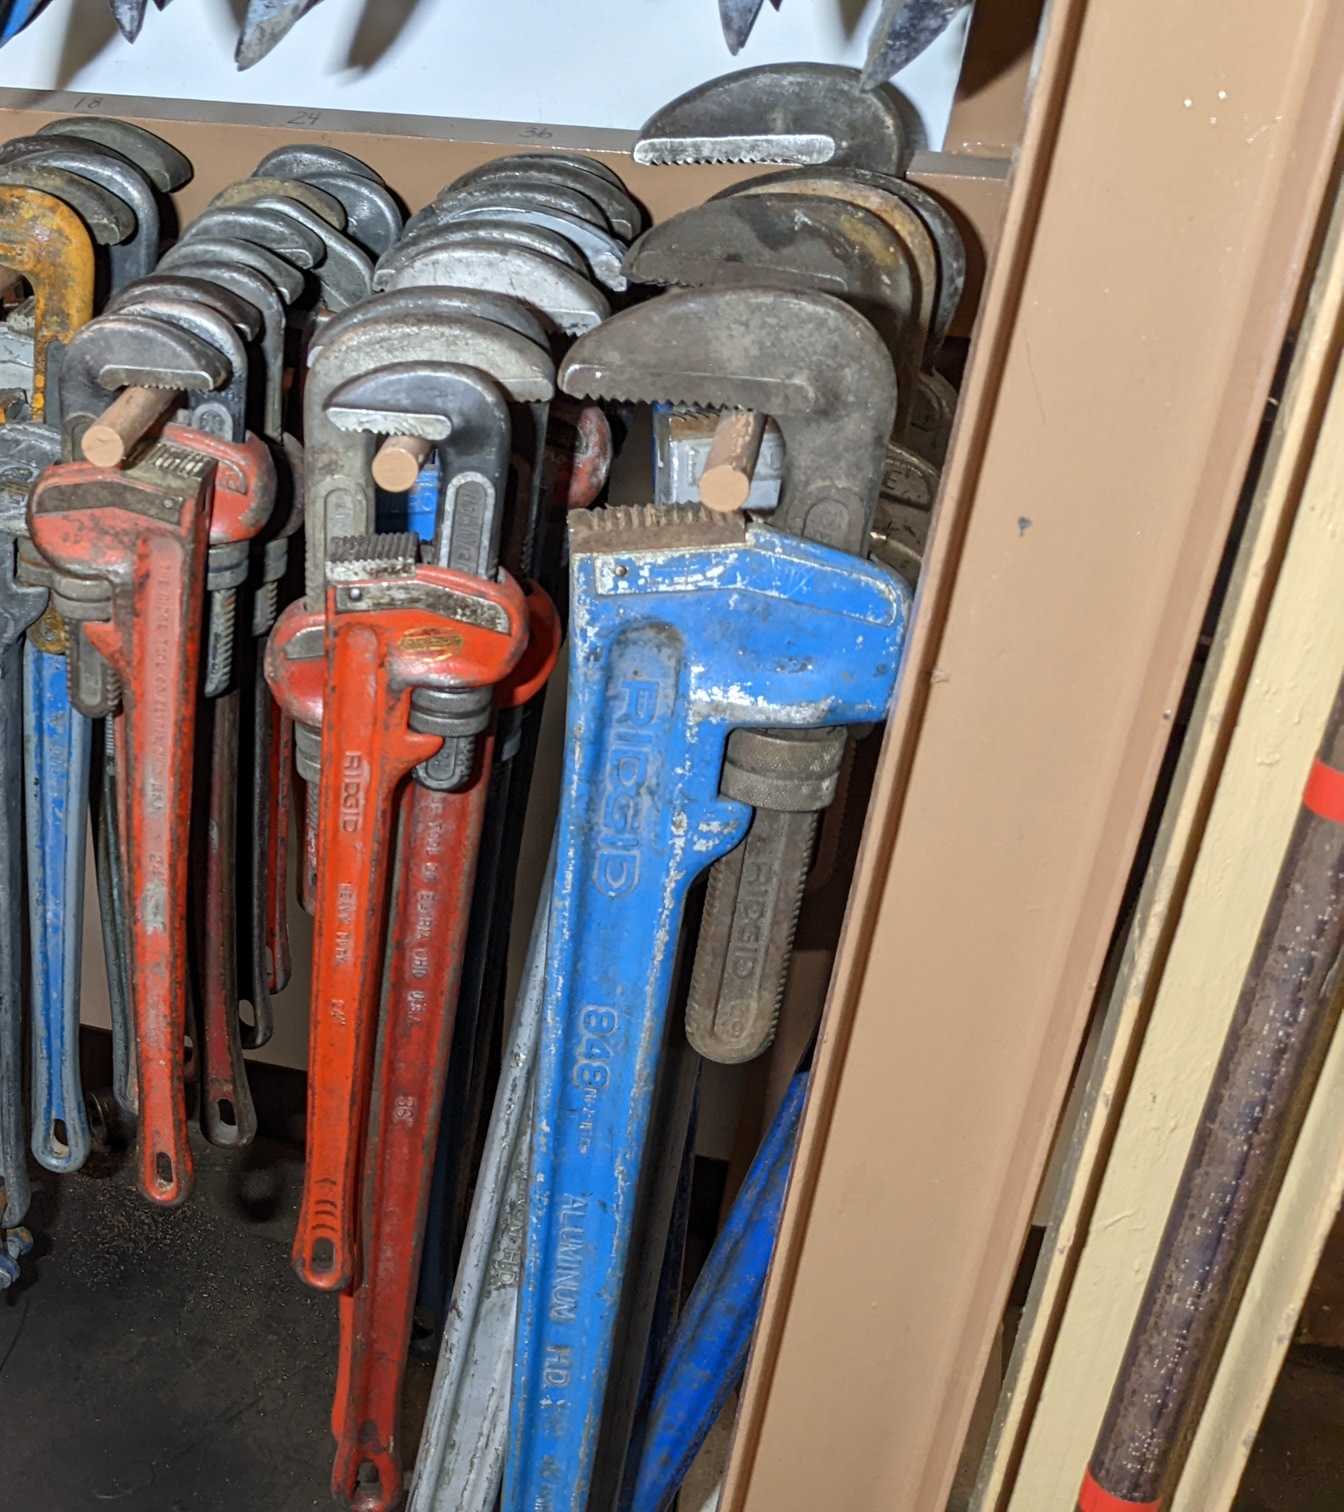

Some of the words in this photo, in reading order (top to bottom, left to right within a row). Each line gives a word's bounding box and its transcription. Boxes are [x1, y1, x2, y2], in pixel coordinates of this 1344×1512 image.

[73, 96, 103, 110] 18
[286, 110, 321, 126] 24
[519, 125, 553, 139] 36
[340, 751, 361, 833] RIDGID
[592, 677, 661, 900] RIDGID
[728, 862, 773, 978] RIDGID
[570, 1005, 619, 1091] 848
[549, 1193, 591, 1326] ALUMINUM
